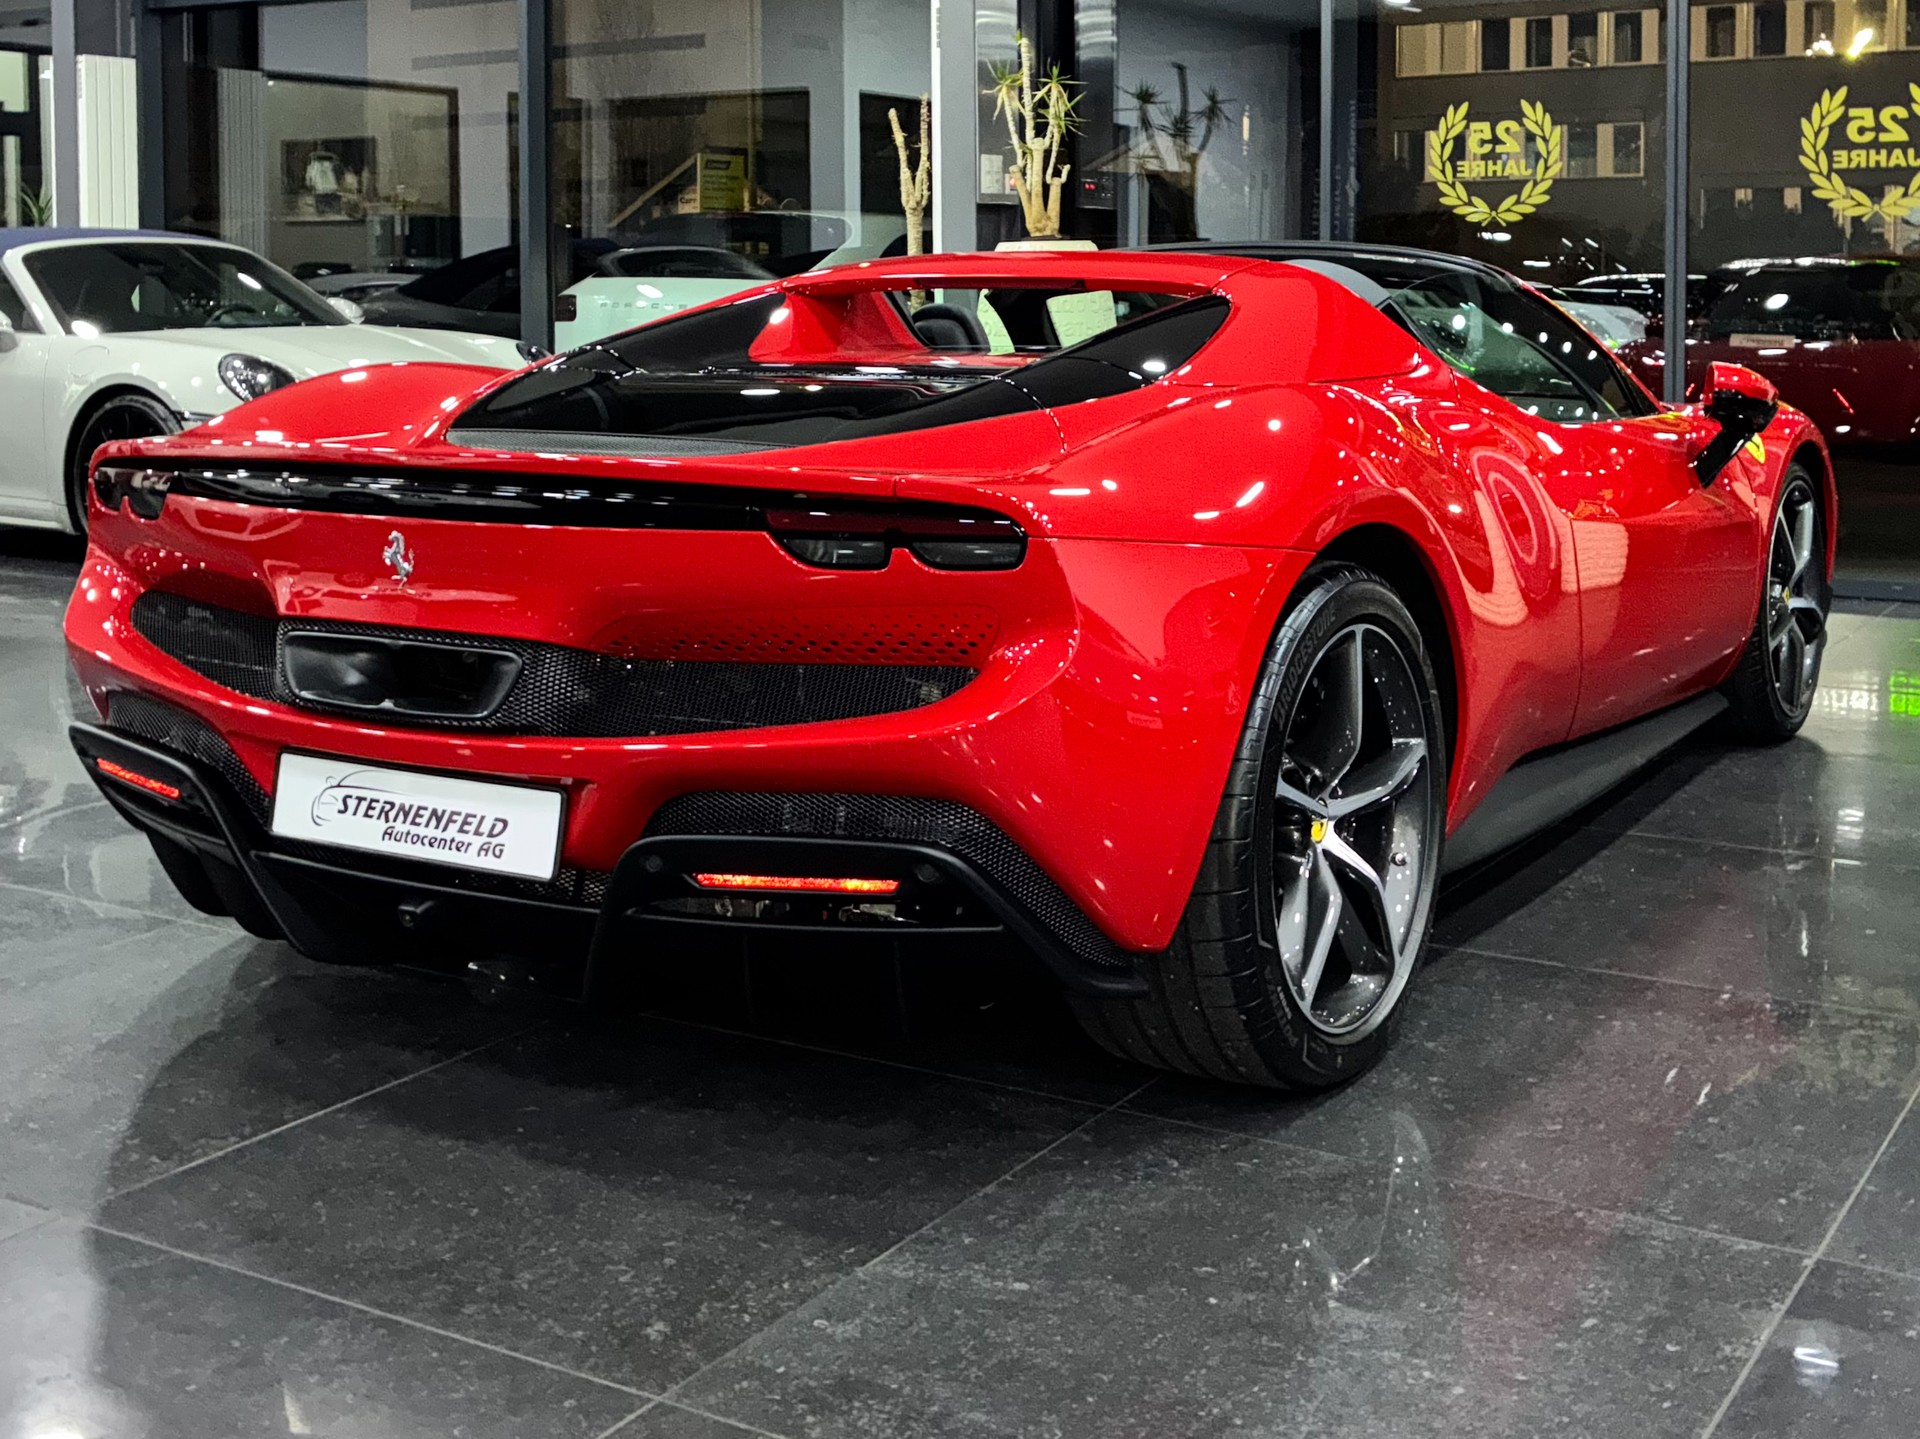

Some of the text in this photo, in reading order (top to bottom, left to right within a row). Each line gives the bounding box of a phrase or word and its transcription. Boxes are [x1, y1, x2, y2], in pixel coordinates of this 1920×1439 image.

[1272, 600, 1338, 732] BRIDGESTONE
[337, 794, 509, 839] STERNENFELD
[381, 825, 506, 860] Autocenter AG
